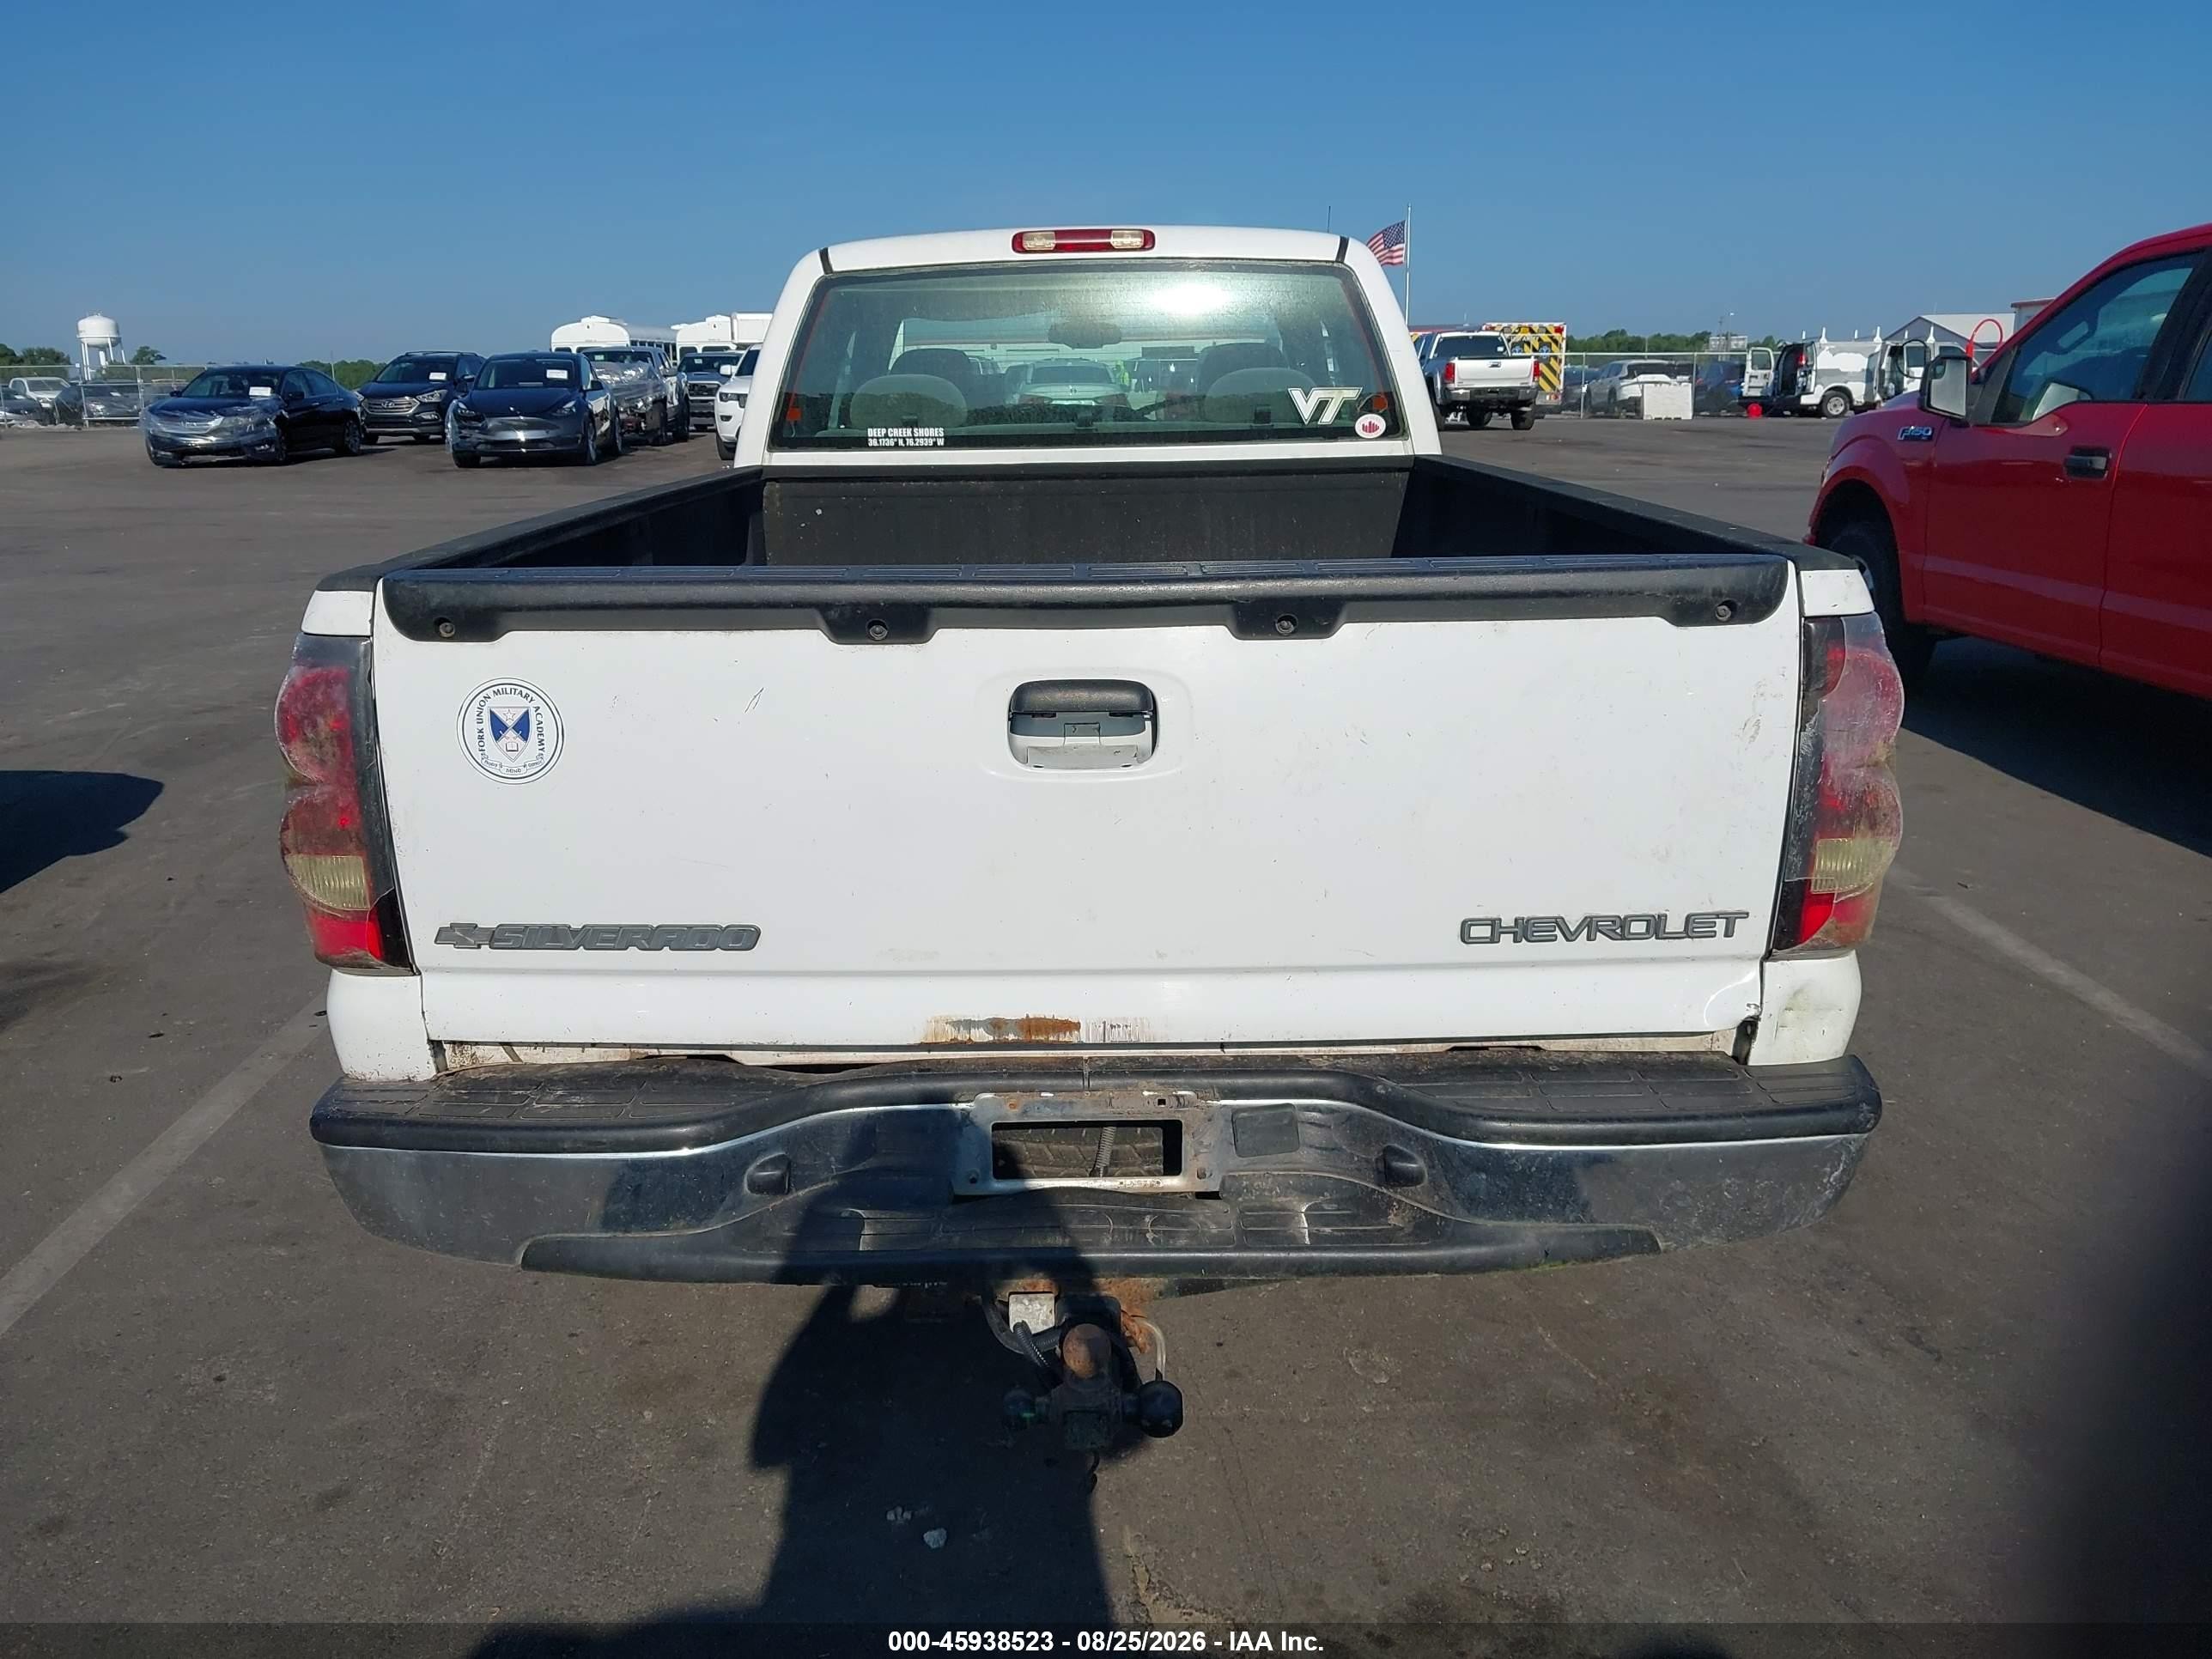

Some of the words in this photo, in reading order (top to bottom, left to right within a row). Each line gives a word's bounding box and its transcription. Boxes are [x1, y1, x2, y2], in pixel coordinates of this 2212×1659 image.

[1288, 387, 1363, 424] VT
[867, 428, 886, 437] DEEP
[887, 428, 913, 437] CREEK
[913, 427, 945, 437] SHORES
[937, 438, 945, 447] W
[492, 687, 536, 703] MILITARY
[476, 694, 491, 725] UNION
[477, 728, 486, 752] FORK
[532, 706, 545, 753] ACADEMY
[488, 924, 762, 951] SILVERADO
[1460, 912, 1749, 944] CHEVROLET
